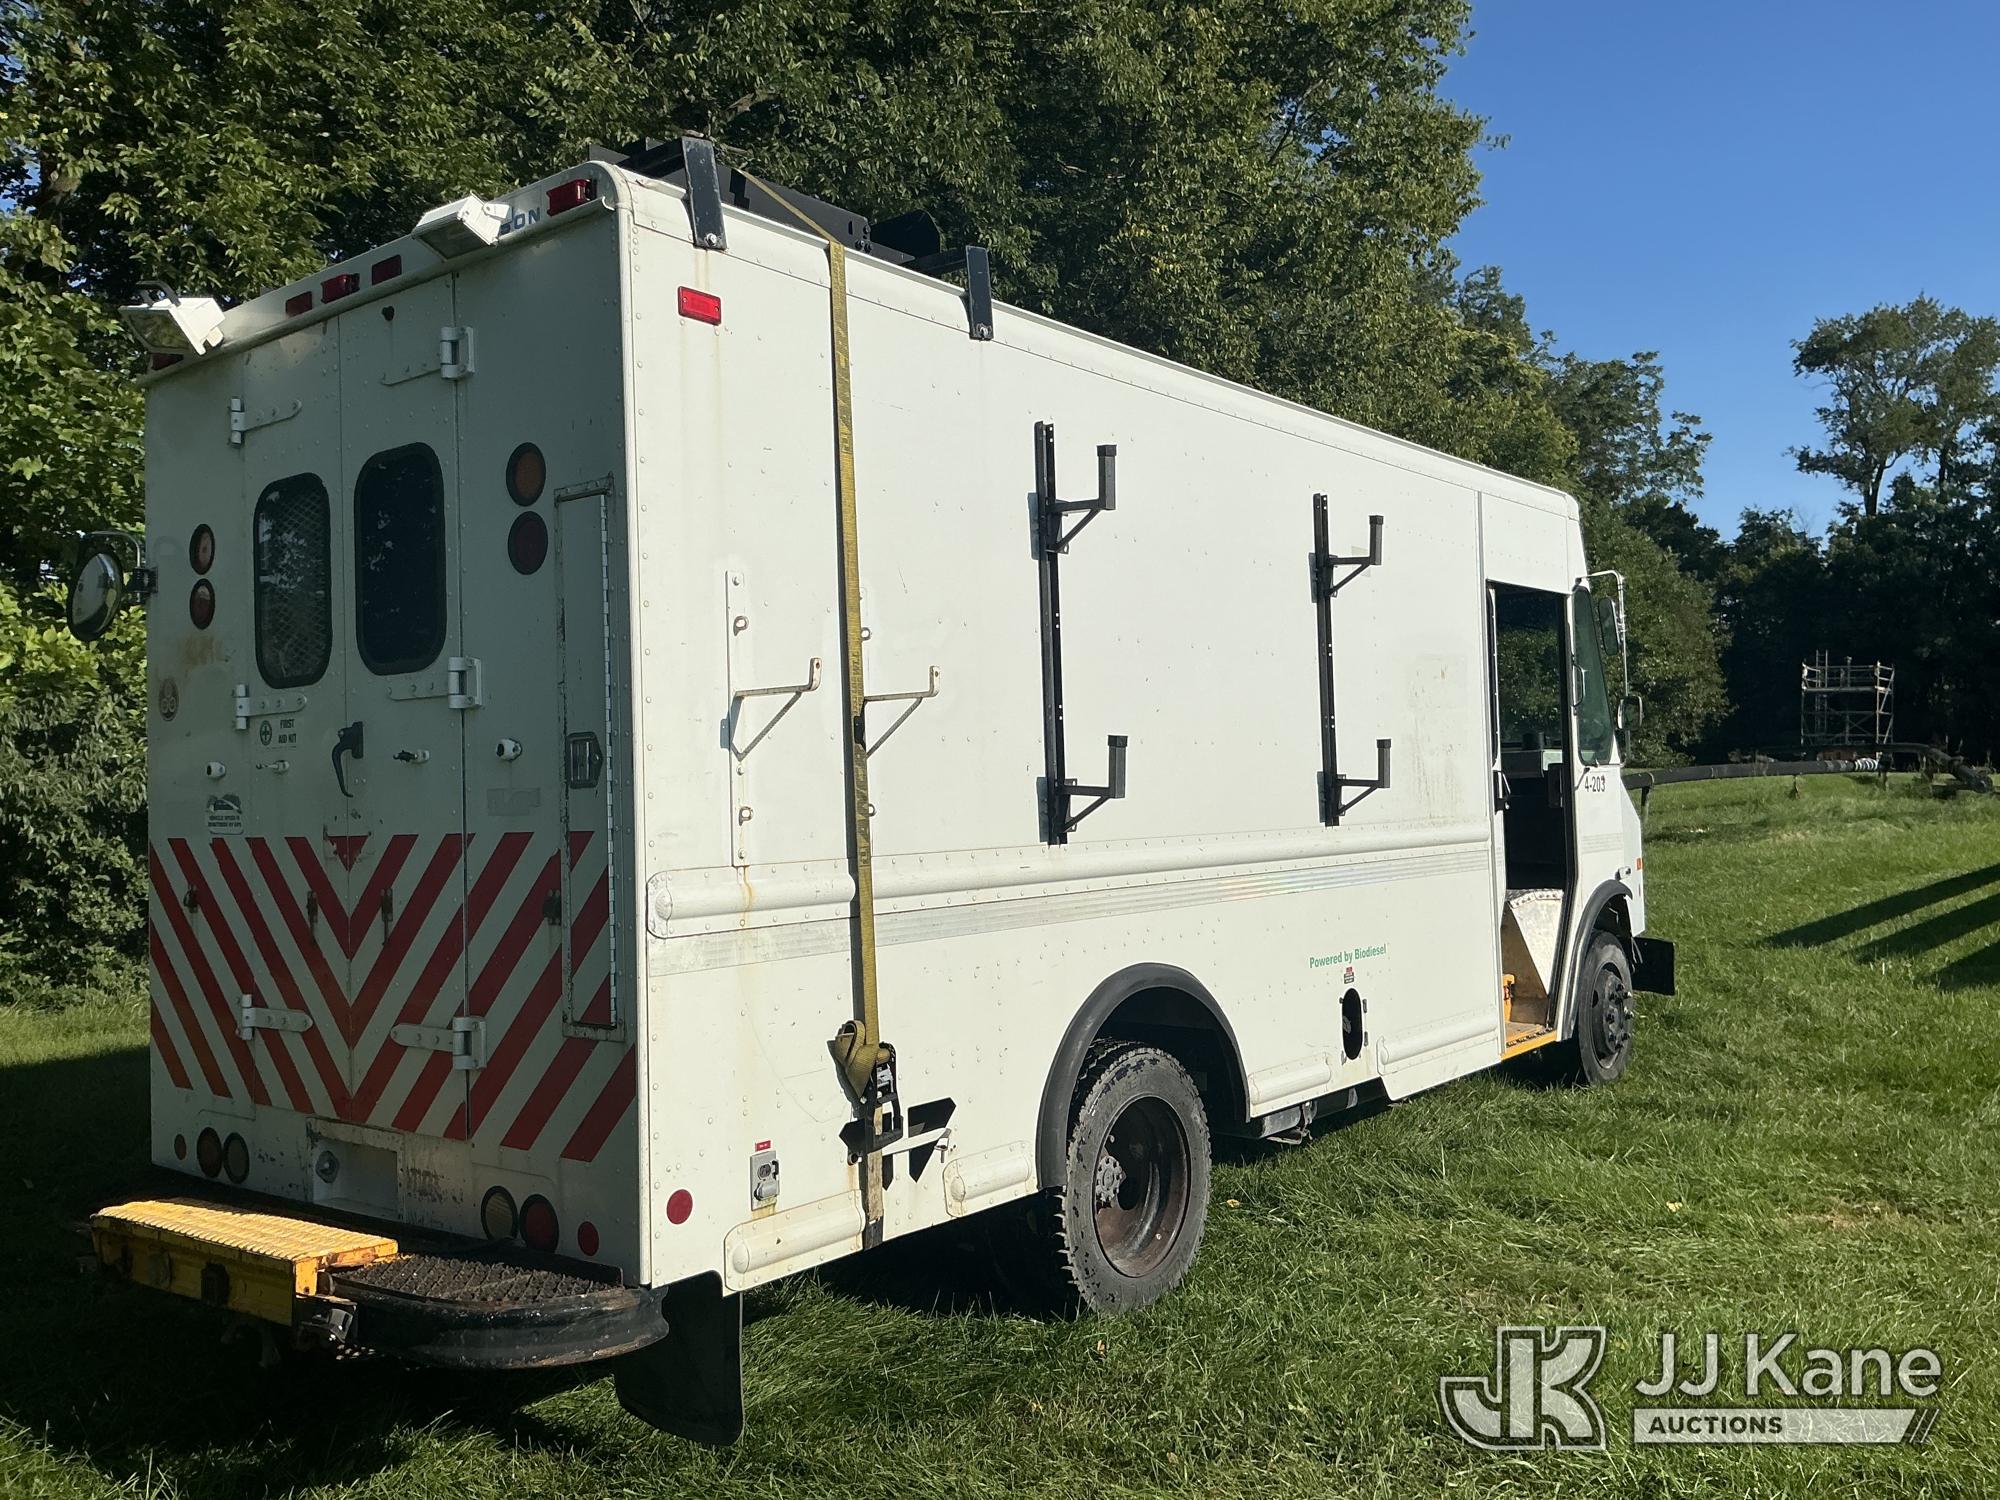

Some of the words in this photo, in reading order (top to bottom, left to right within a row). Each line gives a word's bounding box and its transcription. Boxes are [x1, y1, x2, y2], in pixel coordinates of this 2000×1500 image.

[280, 718, 295, 729] FIRST
[278, 734, 288, 744] AID
[288, 733, 297, 743] KIT
[1584, 774, 1606, 793] 4-203
[1309, 952, 1342, 968] Powered
[1344, 950, 1353, 964] by
[1354, 943, 1387, 960] Biodiesel
